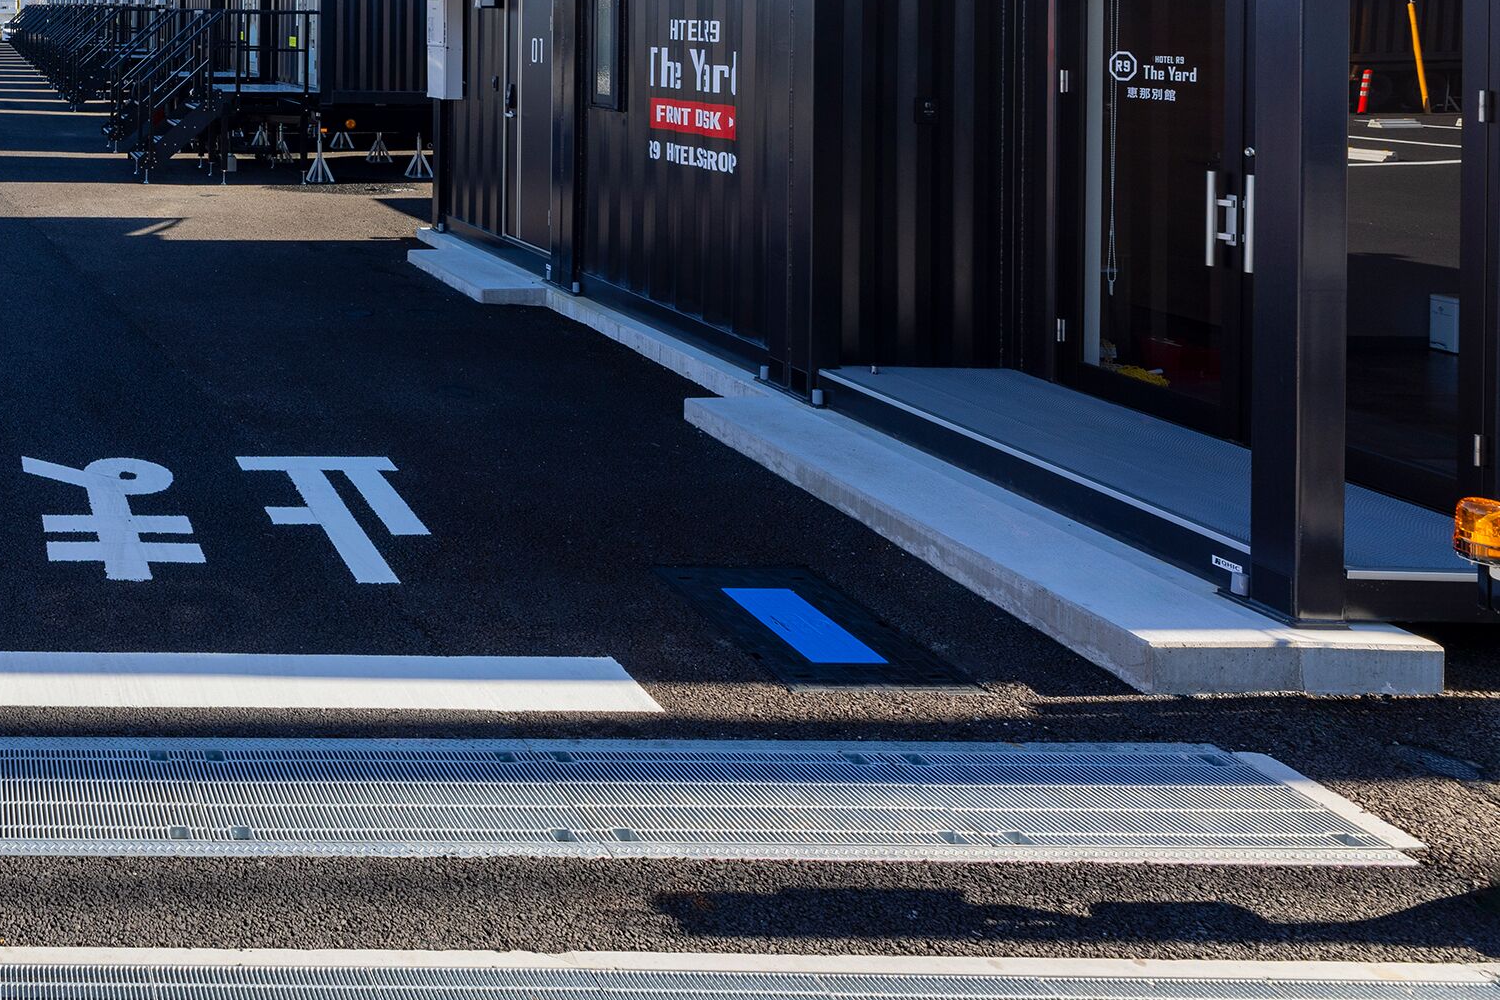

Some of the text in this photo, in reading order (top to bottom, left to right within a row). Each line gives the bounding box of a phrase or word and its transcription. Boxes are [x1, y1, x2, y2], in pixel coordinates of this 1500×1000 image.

[670, 19, 703, 41] HTEL
[532, 37, 543, 63] 01
[1154, 55, 1185, 64] HOTEL R9
[1115, 60, 1131, 72] R9
[1143, 65, 1197, 82] The Yard
[656, 104, 722, 131] FRNT DSK
